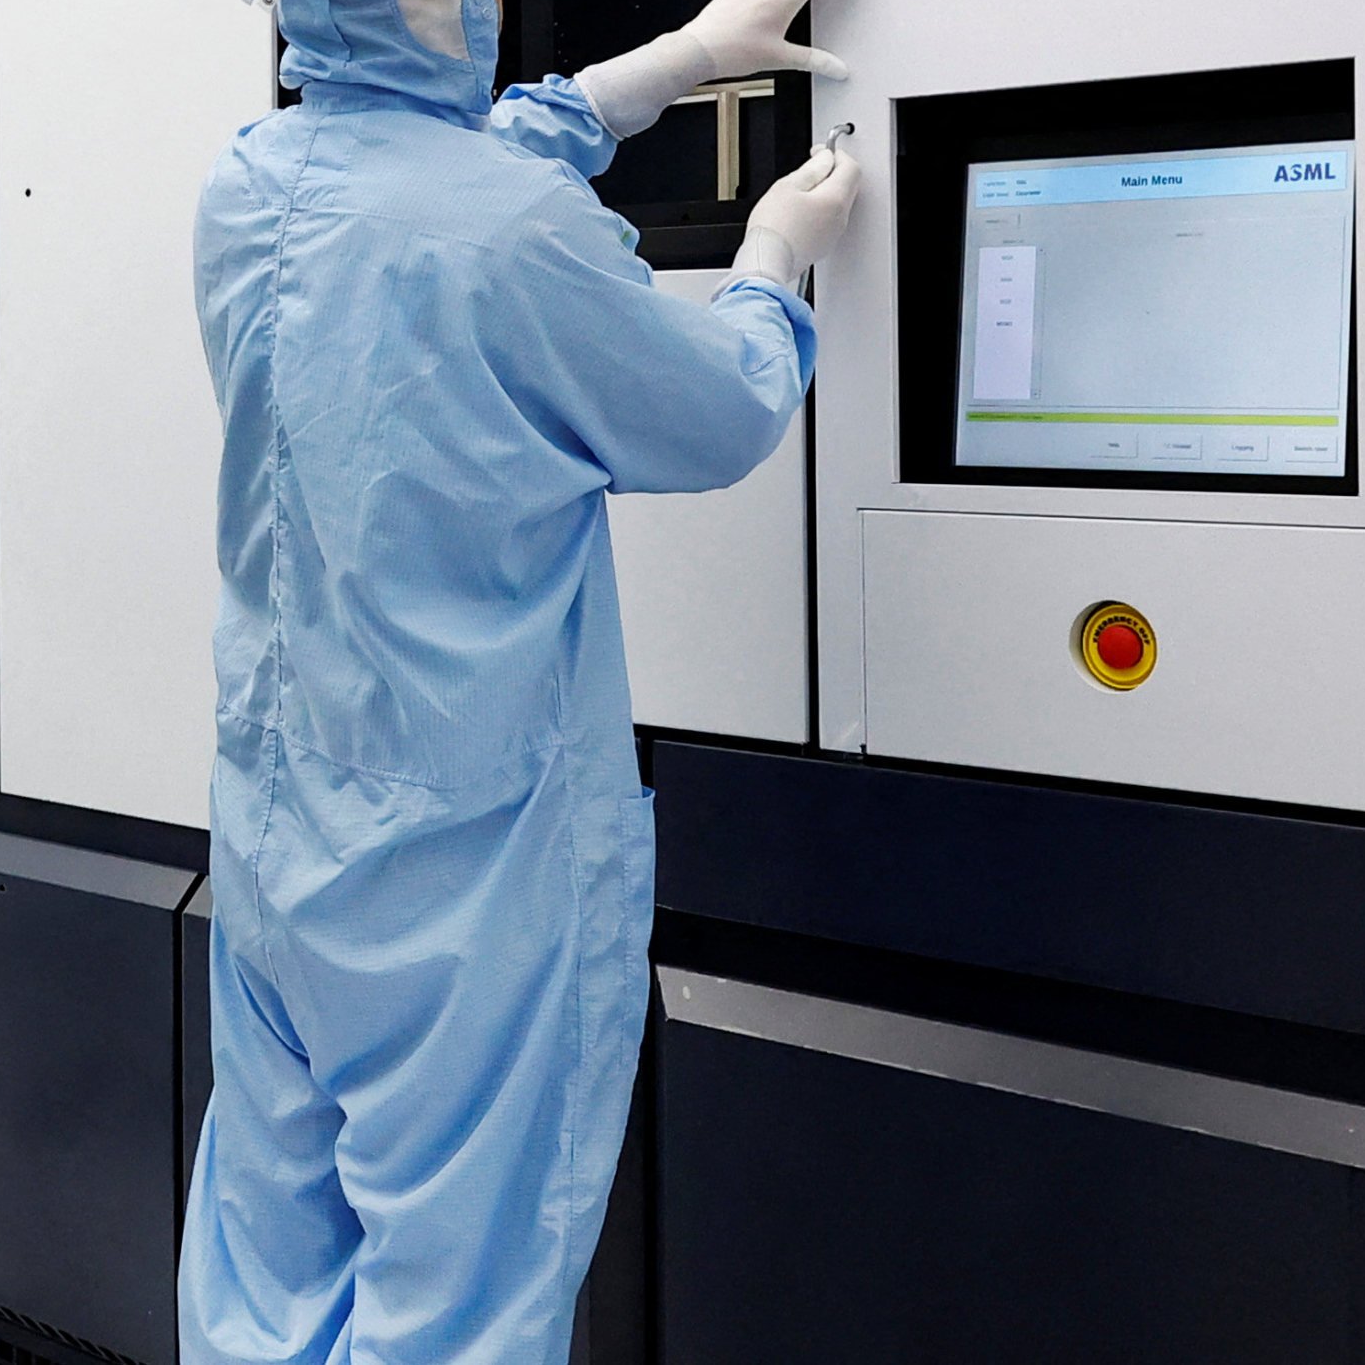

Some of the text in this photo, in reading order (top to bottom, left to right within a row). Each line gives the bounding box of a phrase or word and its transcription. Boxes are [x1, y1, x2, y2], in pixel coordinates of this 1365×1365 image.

[1274, 162, 1336, 183] ASML
[1121, 175, 1183, 187] Main Menu
